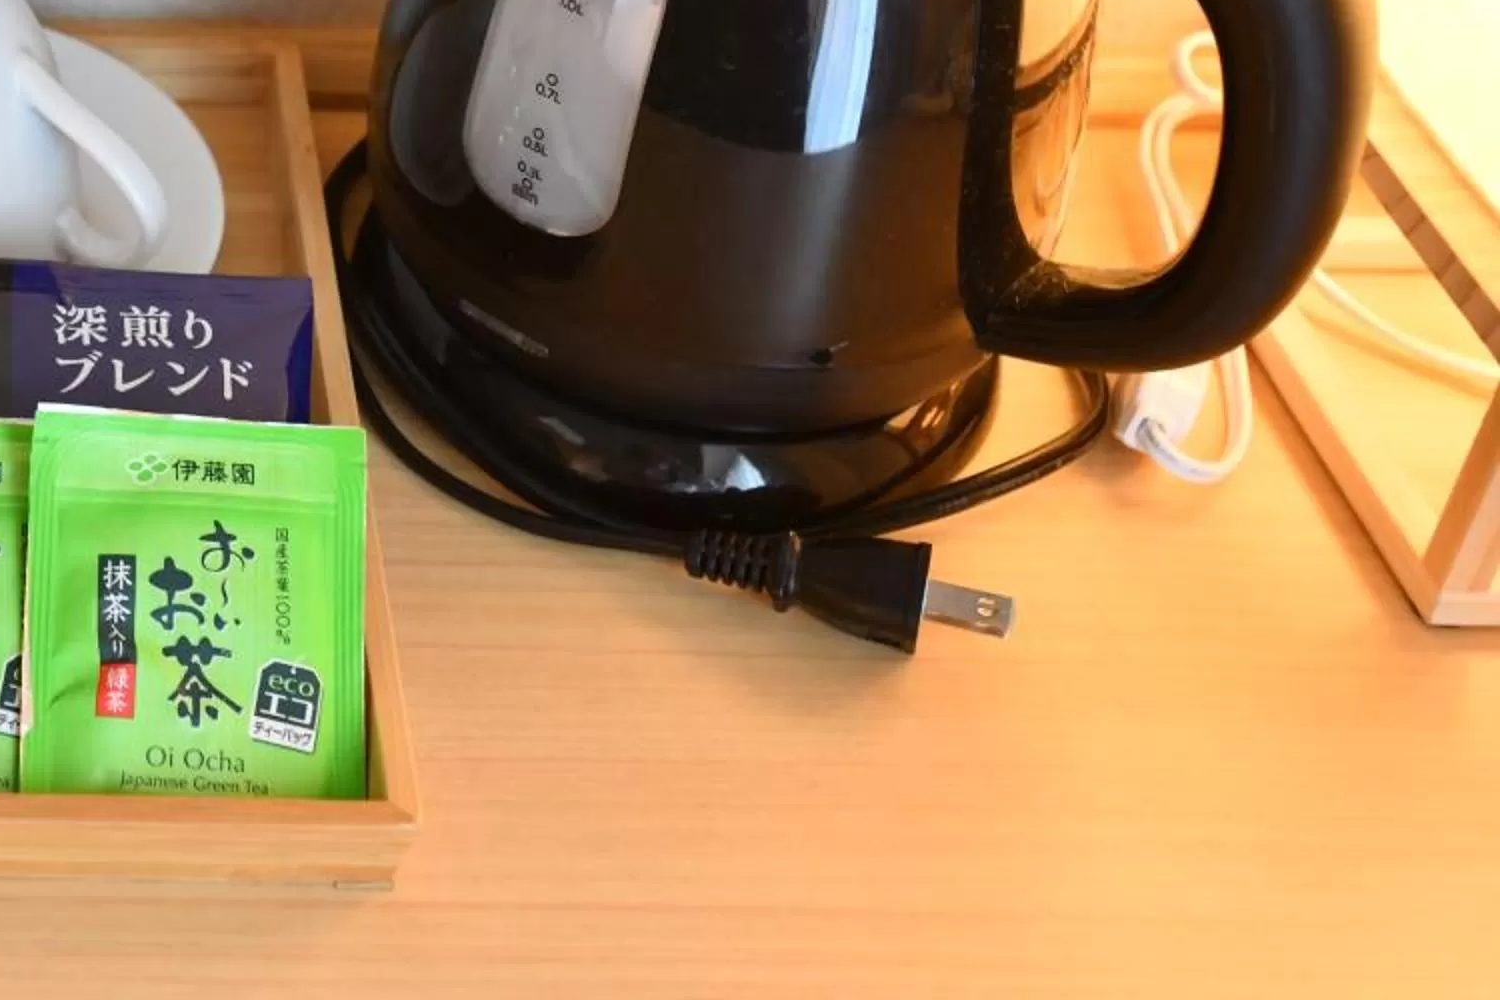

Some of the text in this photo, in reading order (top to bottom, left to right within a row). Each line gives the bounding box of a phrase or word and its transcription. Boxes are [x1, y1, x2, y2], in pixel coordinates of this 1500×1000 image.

[52, 303, 214, 350] 深煎り
[55, 349, 254, 401] ブレンド
[171, 458, 255, 486] 伊藤園
[102, 558, 133, 658] 抹茶入り
[268, 674, 315, 697] eco
[260, 691, 315, 725] エコ
[145, 745, 245, 774] Oi Ocha
[119, 770, 270, 796] Japanese Green Tea
